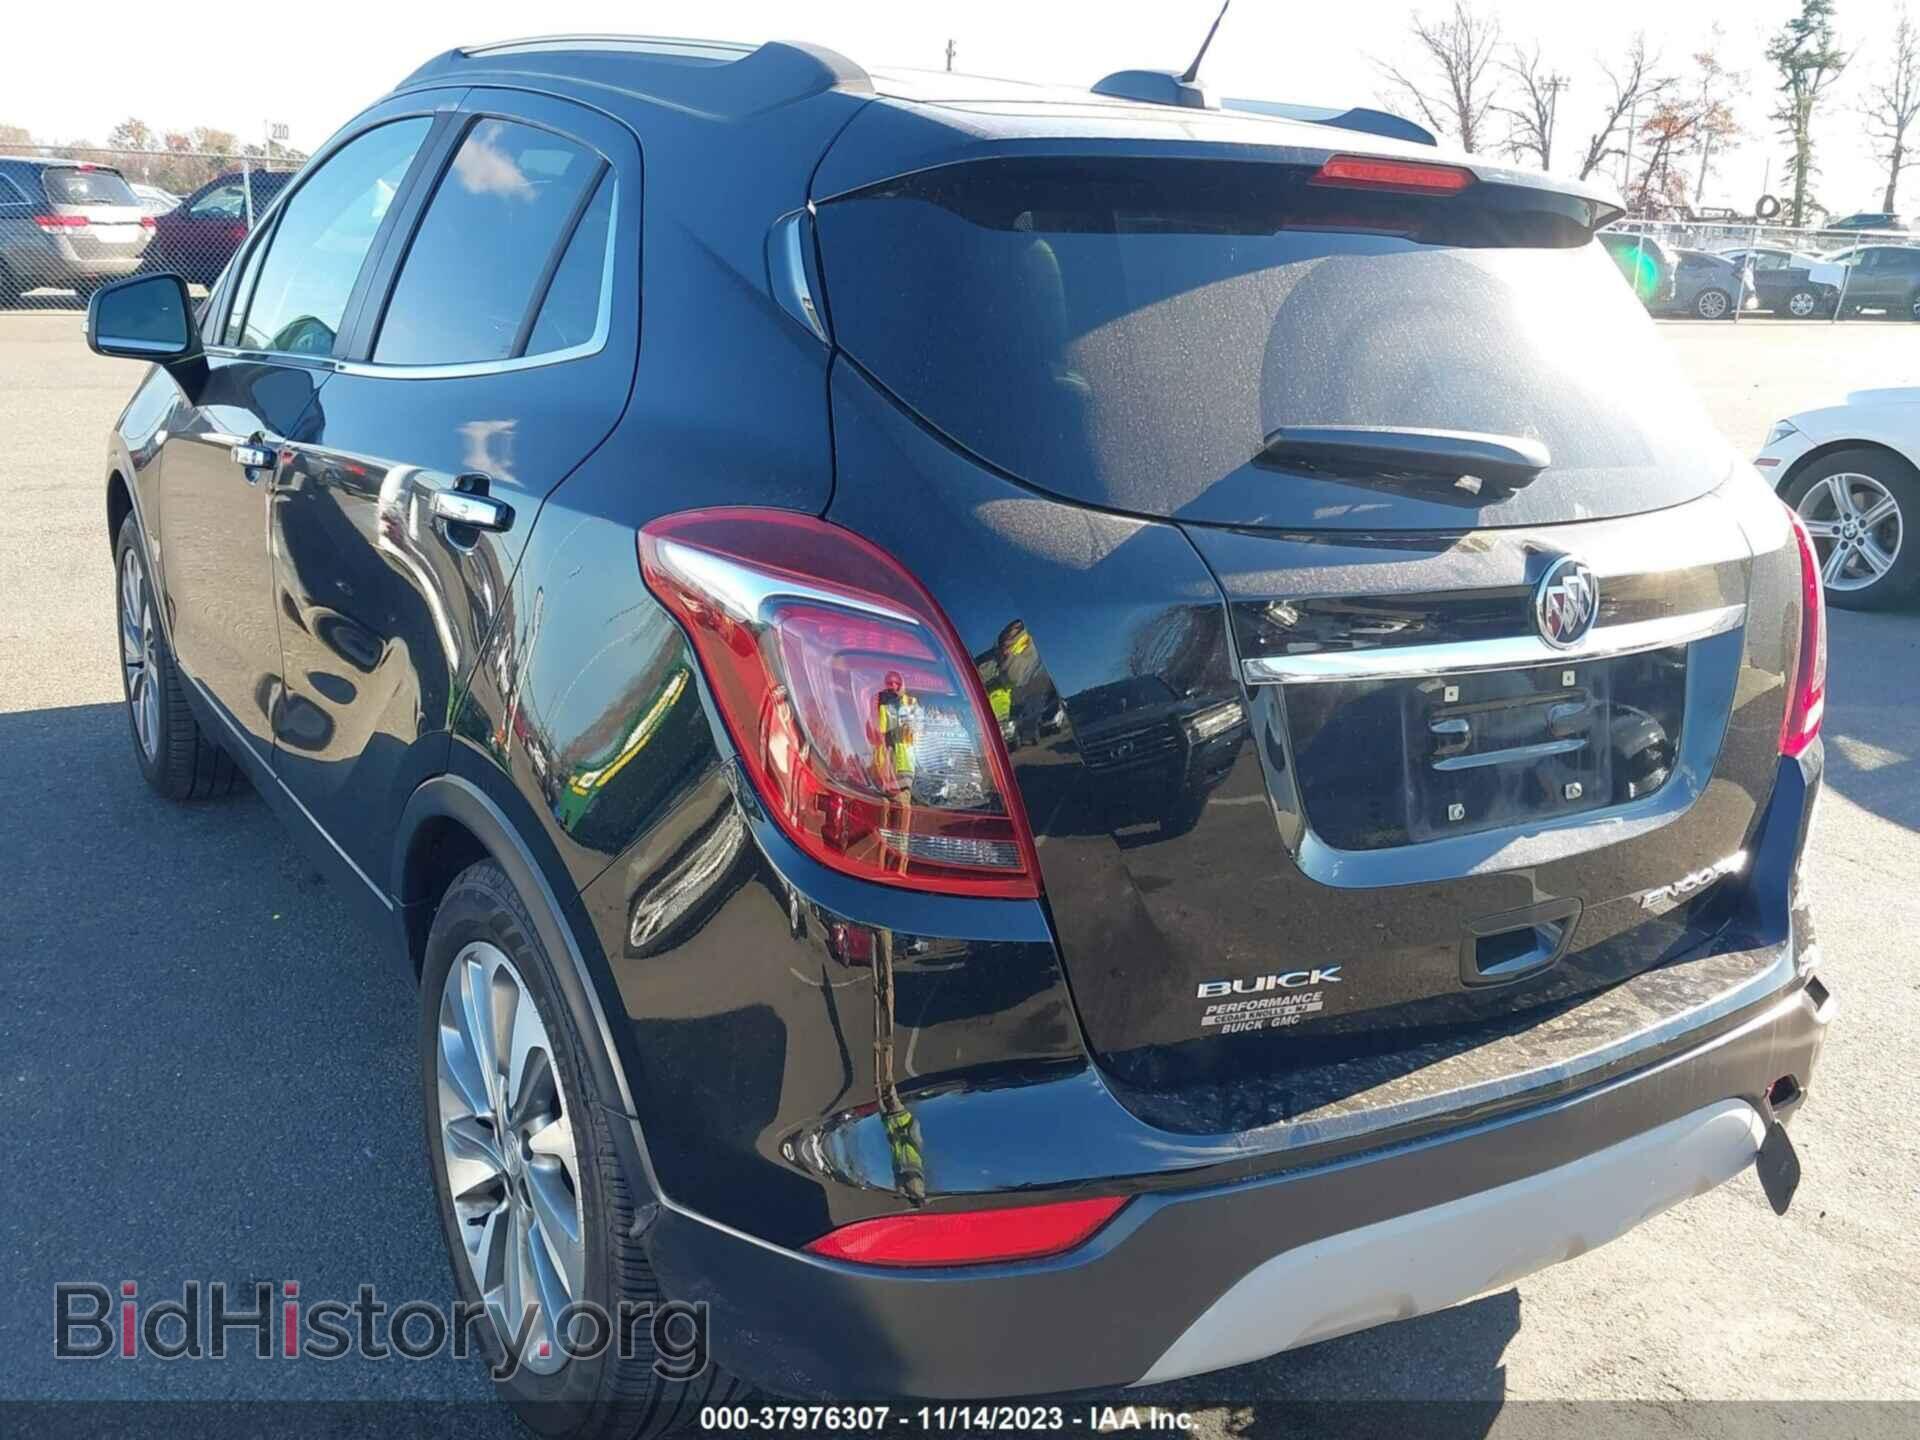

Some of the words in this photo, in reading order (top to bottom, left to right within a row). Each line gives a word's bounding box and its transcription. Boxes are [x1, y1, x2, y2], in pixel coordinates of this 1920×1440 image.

[271, 123, 289, 140] 210
[1641, 851, 1748, 909] ENCO
[1197, 966, 1342, 998] BUICK
[1206, 992, 1322, 1015] PERFORMANCE
[1221, 1020, 1263, 1034] BUICK
[1271, 1014, 1300, 1027] GMC
